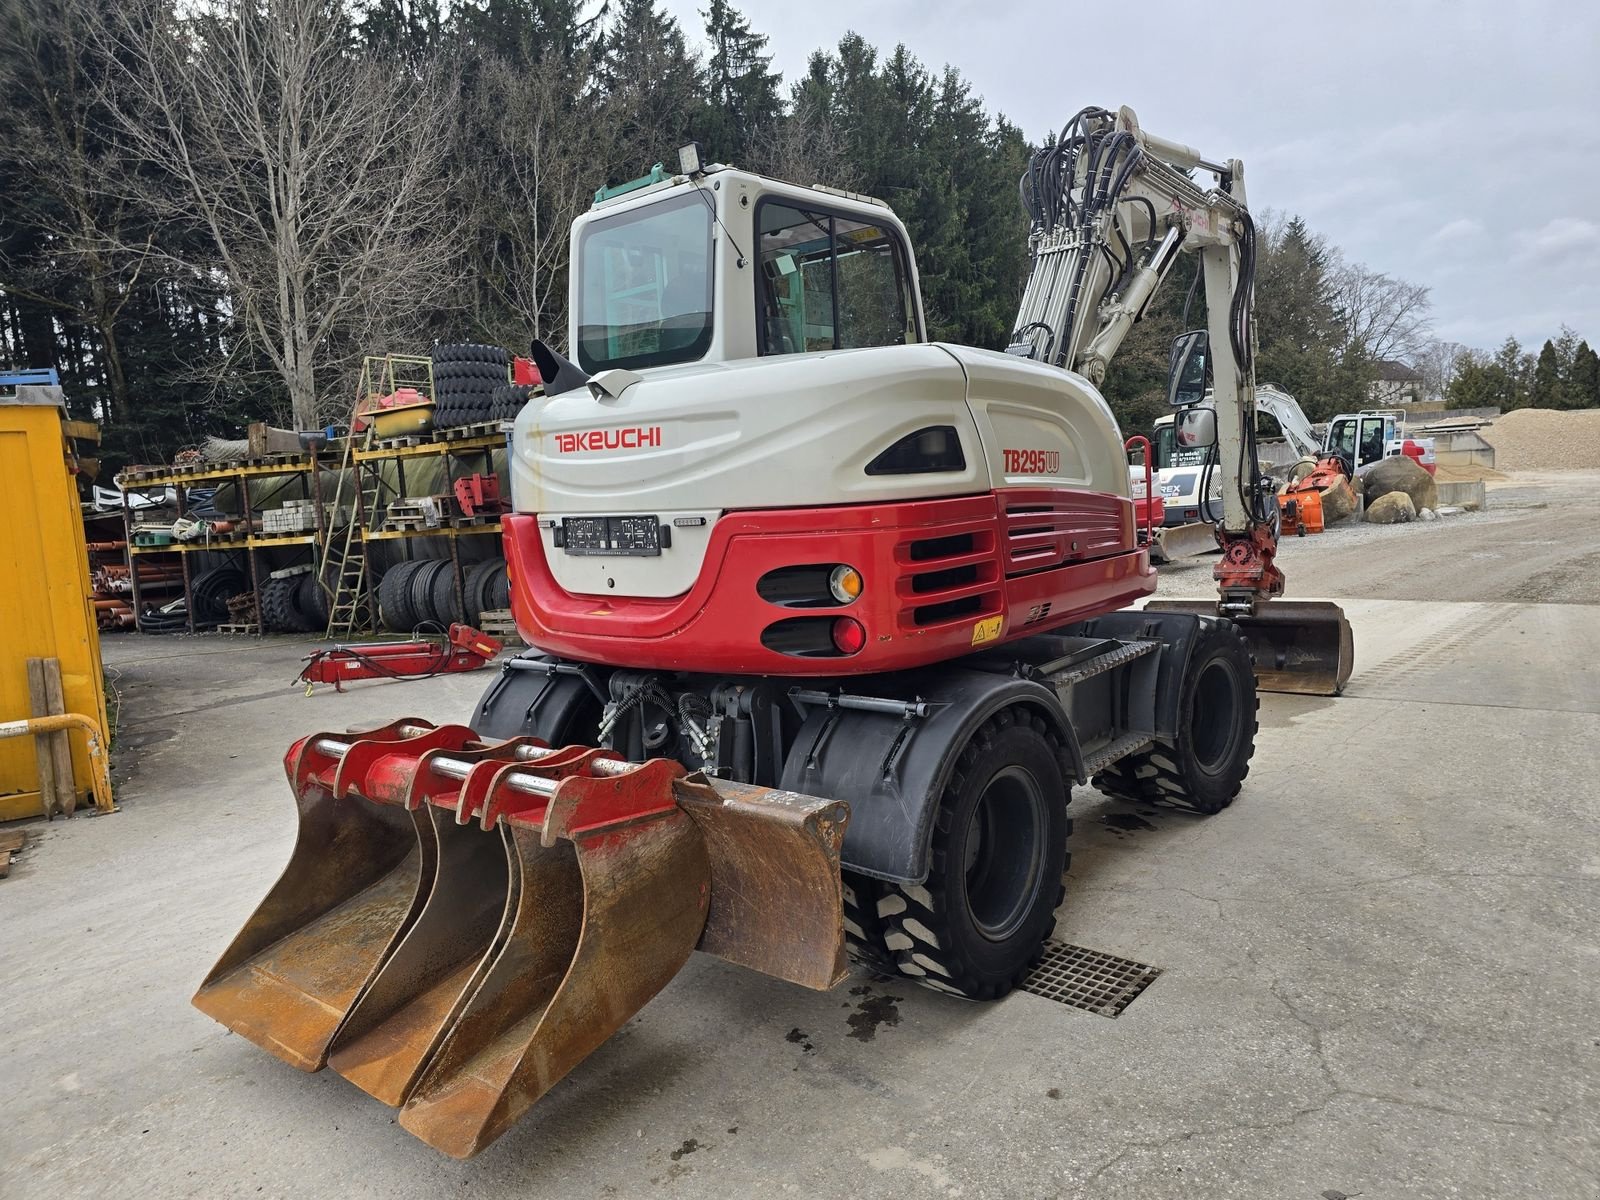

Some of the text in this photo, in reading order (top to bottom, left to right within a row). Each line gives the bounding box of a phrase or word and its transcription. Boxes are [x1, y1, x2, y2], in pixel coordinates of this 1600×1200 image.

[555, 427, 661, 453] TAKEUCHI
[1003, 449, 1060, 474] TB295W
[1160, 485, 1181, 493] REX
